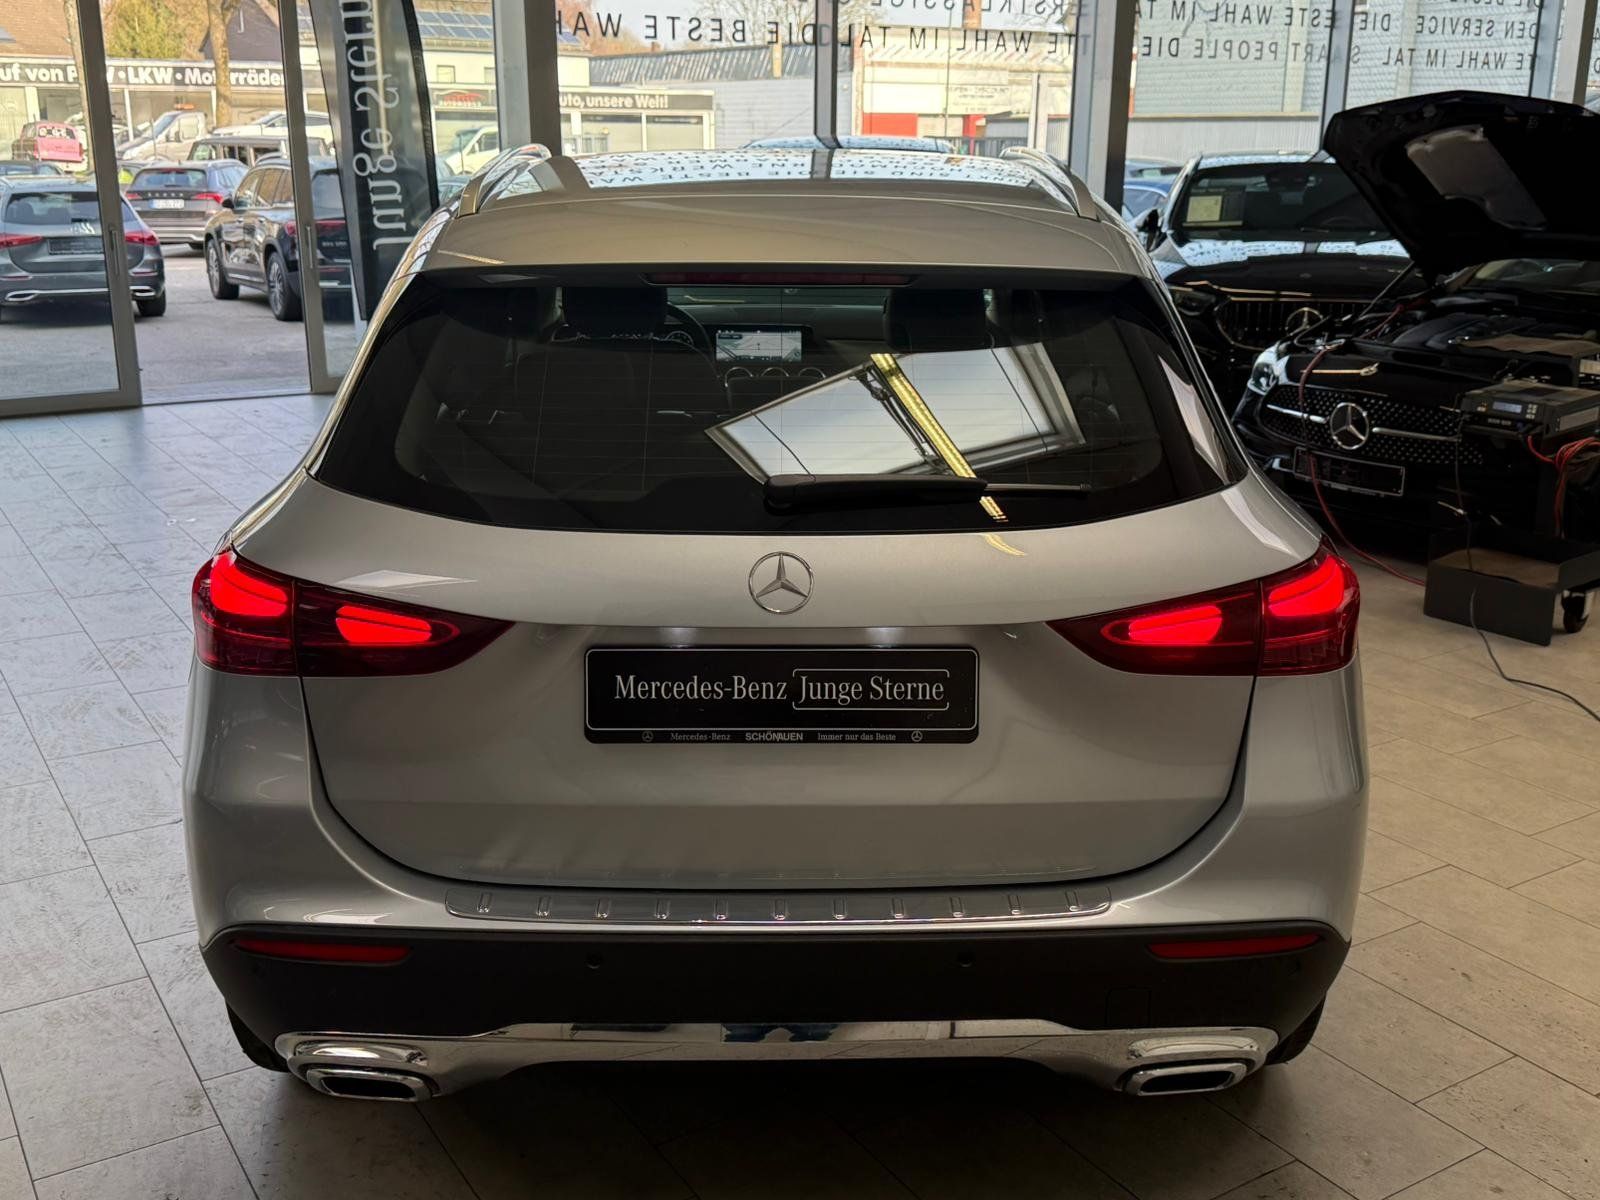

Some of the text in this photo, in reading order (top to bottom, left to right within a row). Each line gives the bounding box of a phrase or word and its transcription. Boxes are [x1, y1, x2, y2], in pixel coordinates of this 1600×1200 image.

[0, 62, 21, 81] uf
[25, 67, 65, 82] von
[127, 66, 173, 85] LKW
[558, 93, 669, 109] uto, unsere Welt!
[614, 674, 945, 706] Mercedes-Benz Junge Sterne
[670, 732, 731, 741] Mercedes-Benz
[817, 732, 843, 741] Immer
[860, 732, 874, 741] das
[876, 732, 897, 741] Beste
